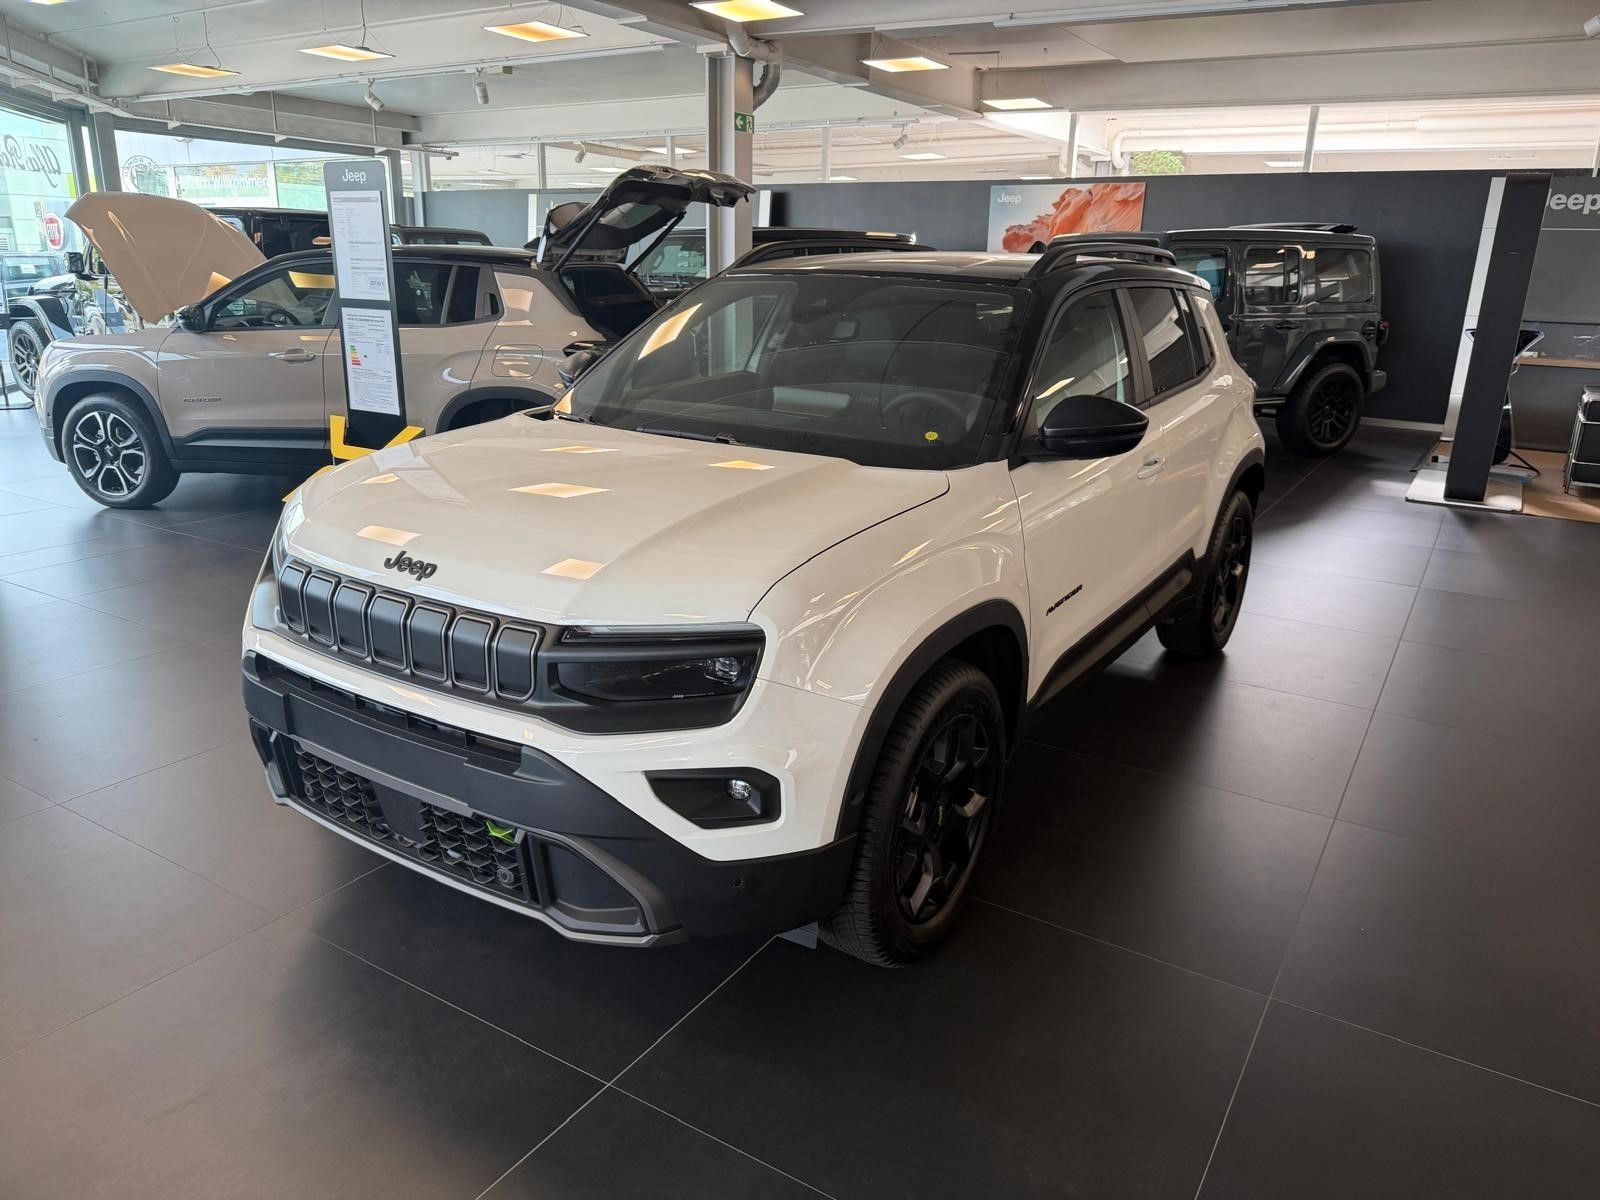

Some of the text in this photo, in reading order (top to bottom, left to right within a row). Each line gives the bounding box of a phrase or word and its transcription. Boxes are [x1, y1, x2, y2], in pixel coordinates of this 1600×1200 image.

[342, 168, 367, 184] Jeep
[997, 192, 1021, 205] Jeep
[383, 550, 438, 581] Jeep
